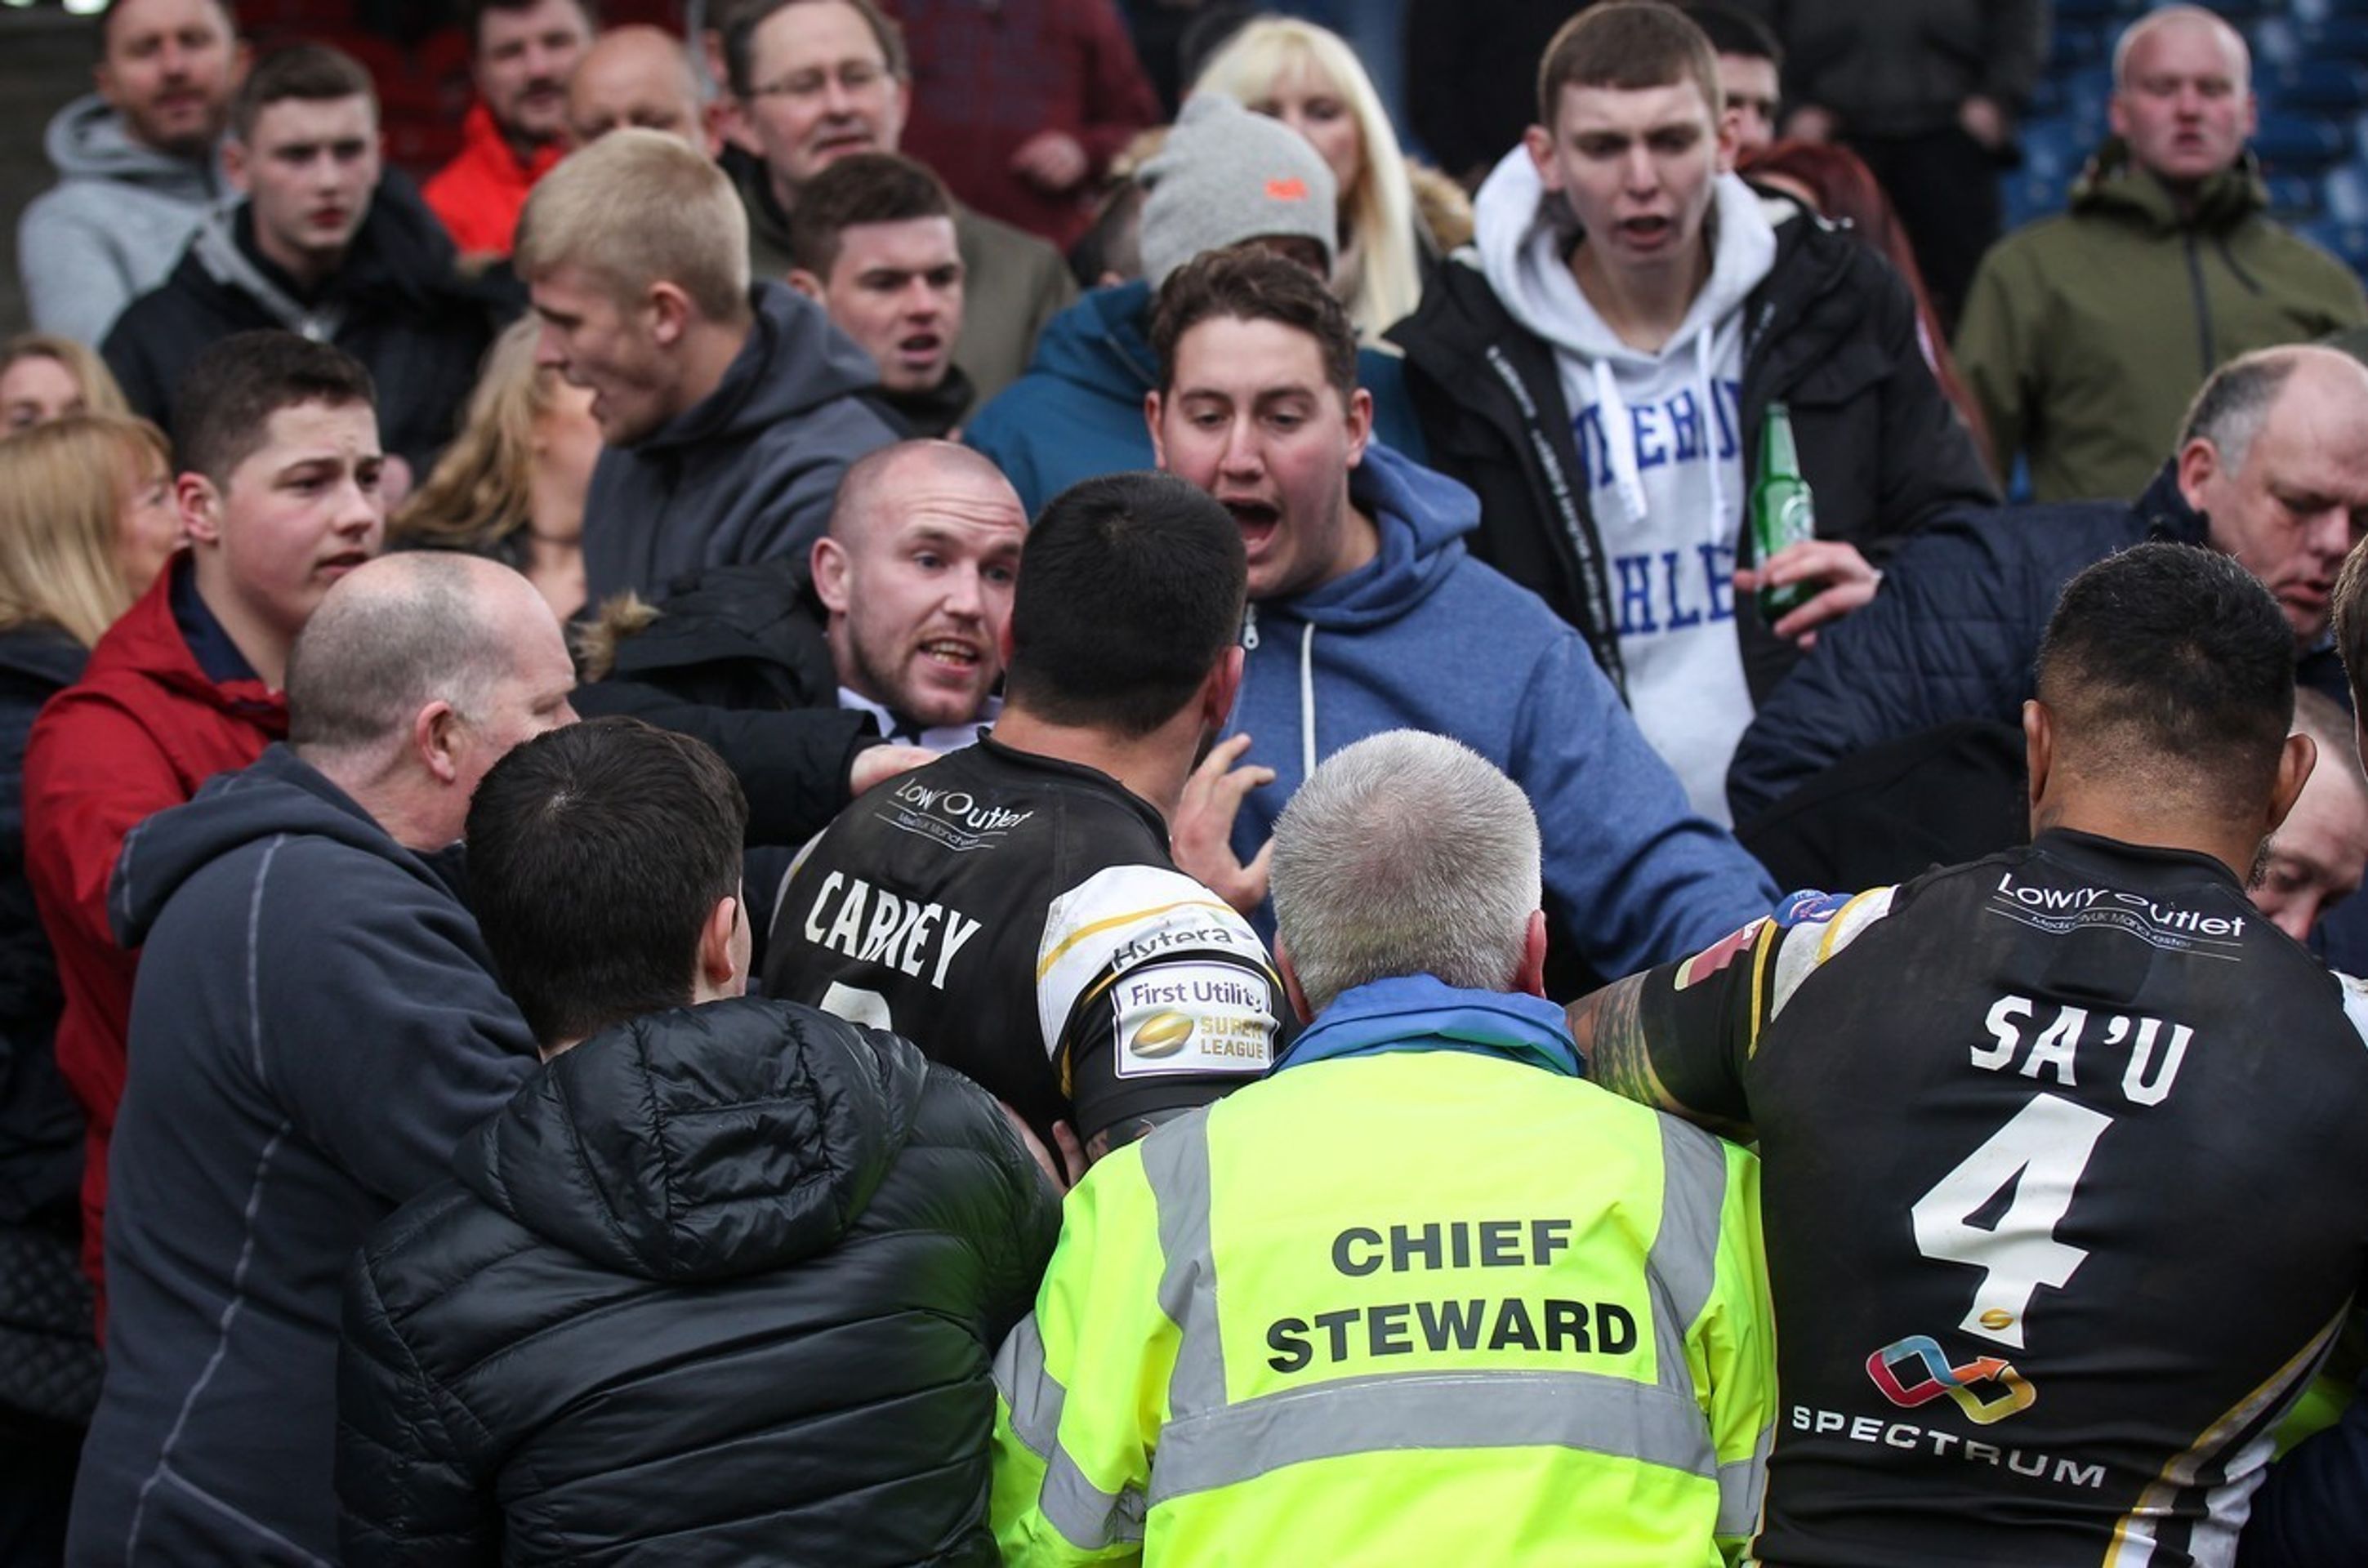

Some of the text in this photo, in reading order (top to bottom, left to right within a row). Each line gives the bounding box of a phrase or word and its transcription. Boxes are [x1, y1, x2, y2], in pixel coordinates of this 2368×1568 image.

[2114, 893, 2245, 937] Outlet
[1113, 928, 1233, 969] Hytera
[1131, 982, 1188, 1006] First
[1201, 1015, 1264, 1040] SUPER
[1201, 1039, 1264, 1059] LEAGUE
[1969, 994, 2194, 1106] SA'U
[1911, 1092, 2114, 1350] 4
[1331, 1219, 1572, 1276] CHIEF
[1266, 1298, 1638, 1373] STEWARD
[1792, 1405, 2107, 1488] SPECTRUM
